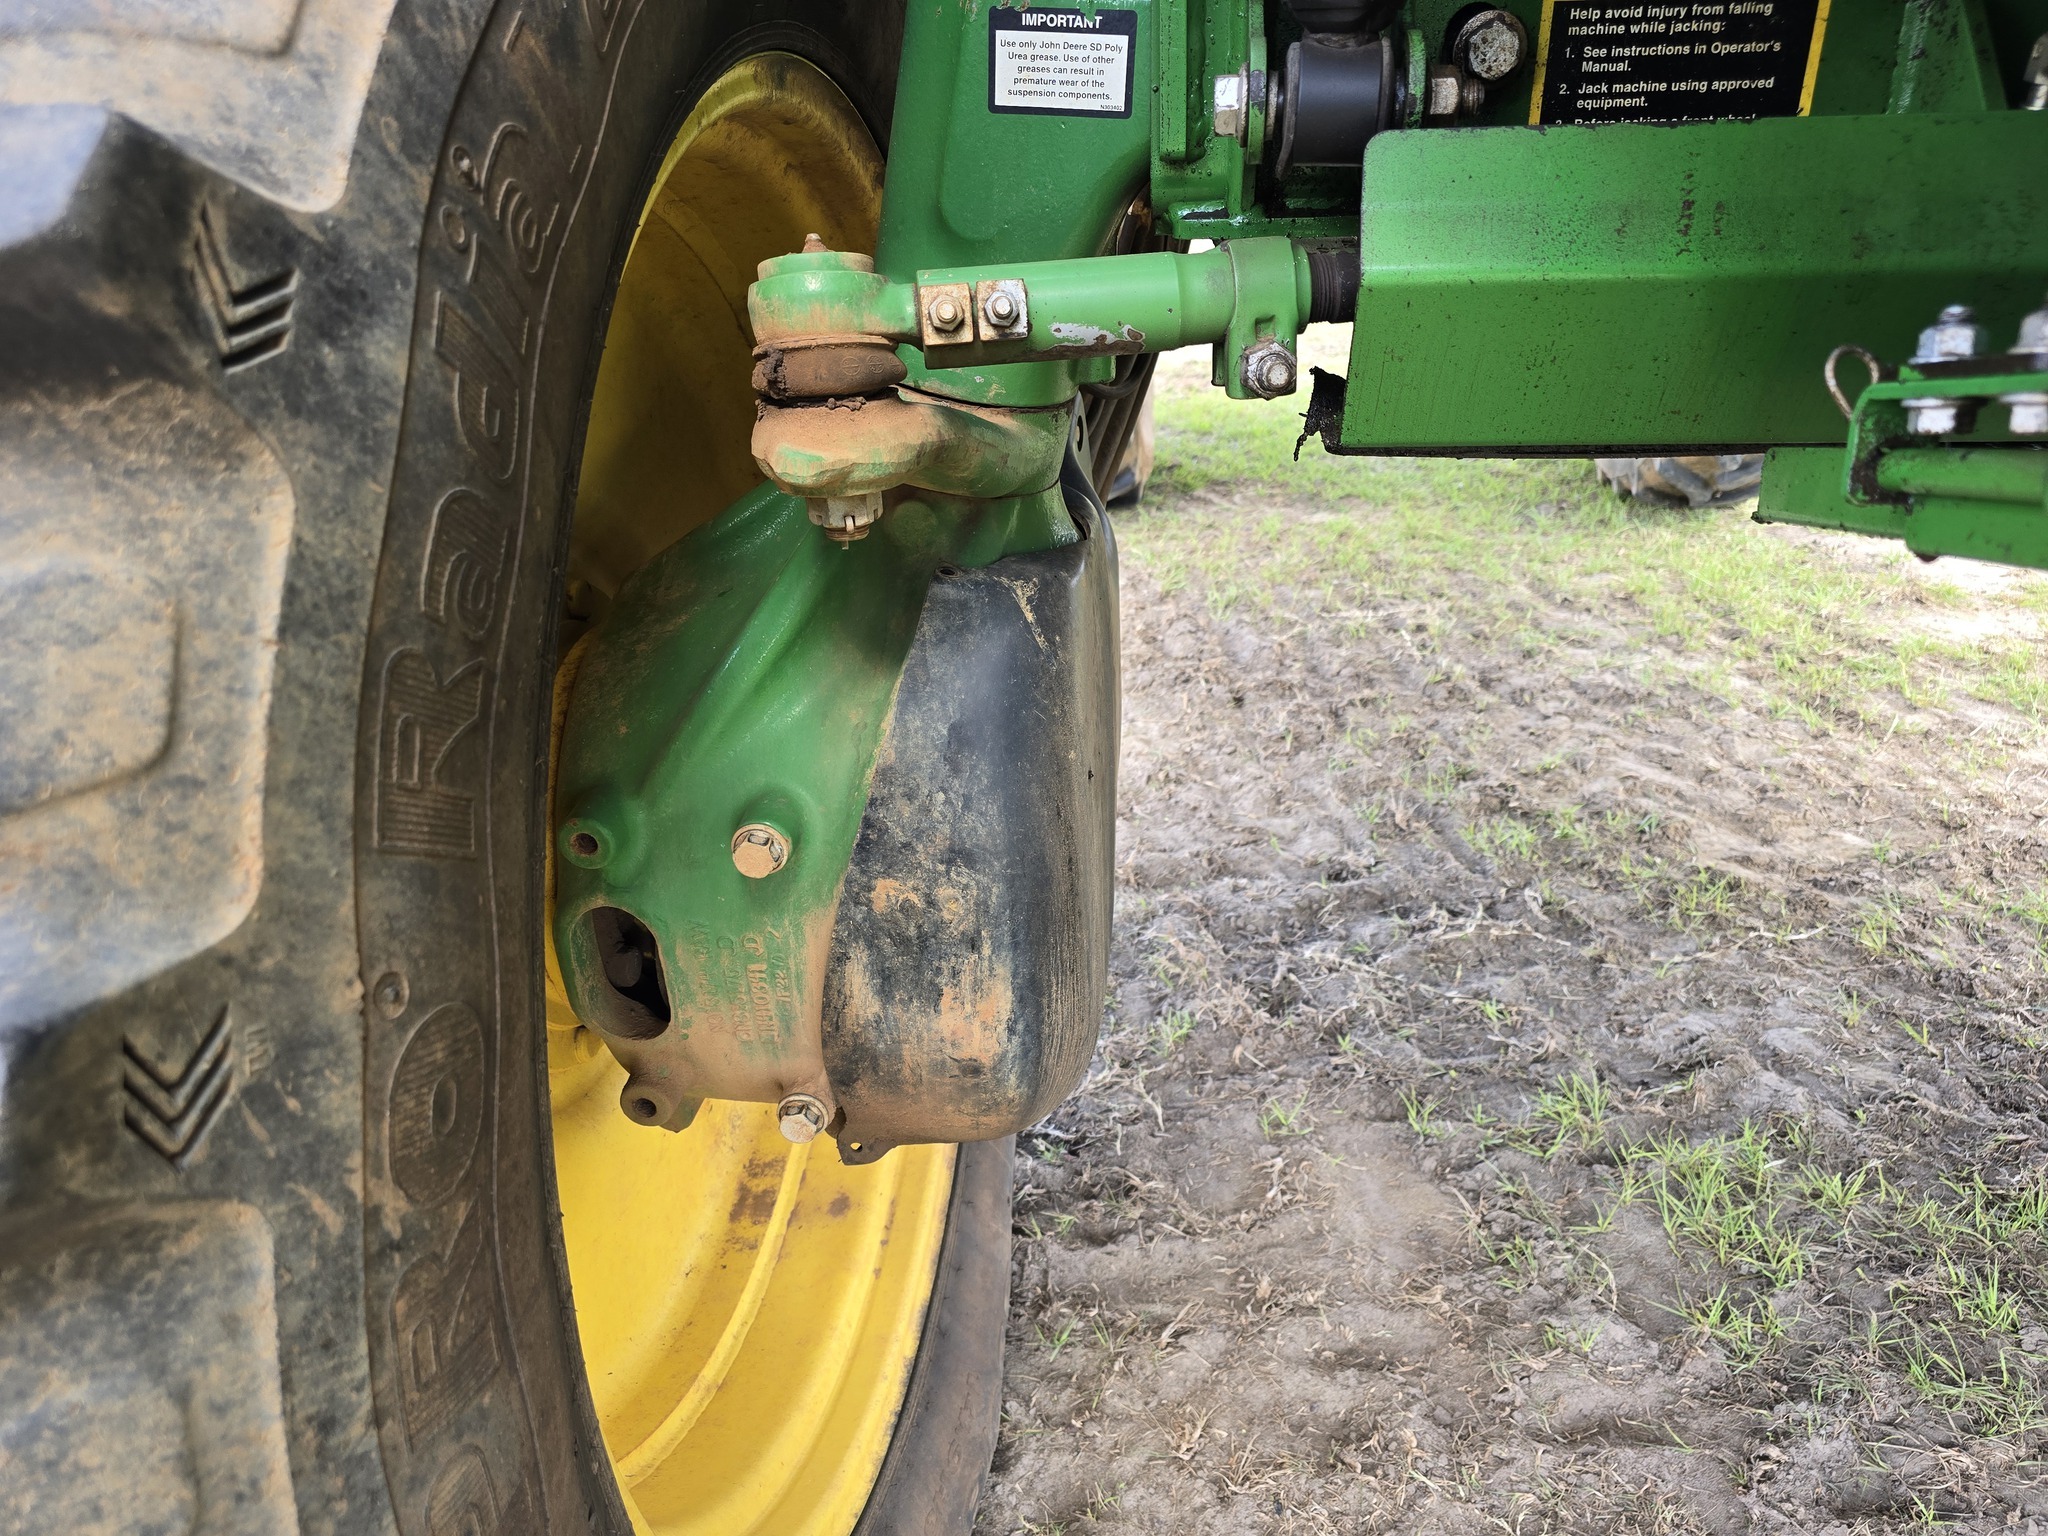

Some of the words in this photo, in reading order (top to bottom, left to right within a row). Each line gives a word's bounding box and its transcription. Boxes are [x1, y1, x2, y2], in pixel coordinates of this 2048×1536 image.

[1570, 8, 1600, 21] Help
[1605, 7, 1642, 19] avoid
[1647, 6, 1686, 20] injury
[1692, 4, 1724, 16] from
[1728, 2, 1774, 16] falling
[1022, 13, 1102, 29] IMPORTANT
[1568, 23, 1625, 36] machine
[1630, 22, 1666, 34] while
[1670, 20, 1726, 36] jacking:
[1001, 39, 1016, 47] Use
[1019, 40, 1037, 50] only
[1040, 41, 1060, 50] John
[1063, 42, 1087, 51] Deere
[1090, 43, 1102, 51] SD
[1105, 44, 1123, 54] Poly
[1564, 48, 1574, 58] 1.
[1583, 46, 1607, 58] See
[1611, 43, 1690, 56] instructions
[1694, 42, 1706, 54] in
[1711, 41, 1781, 56] Operator's
[1008, 52, 1027, 60] Urea
[1030, 54, 1061, 62] grease.
[1082, 54, 1090, 63] of
[1093, 56, 1115, 64] other
[1018, 66, 1050, 75] greases
[1097, 68, 1104, 76] in
[1582, 60, 1632, 73] Manual.
[1013, 77, 1056, 86] premature
[1059, 79, 1078, 87] wear
[1081, 79, 1089, 87] of
[1092, 79, 1105, 88] the
[1559, 84, 1570, 95] 2.
[1578, 82, 1608, 94] Jack
[1612, 80, 1667, 93] machine
[1671, 79, 1707, 94] using
[1711, 76, 1774, 91] approved
[1008, 89, 1056, 97] suspension
[1058, 91, 1112, 100] components.
[1576, 96, 1648, 109] equipment.
